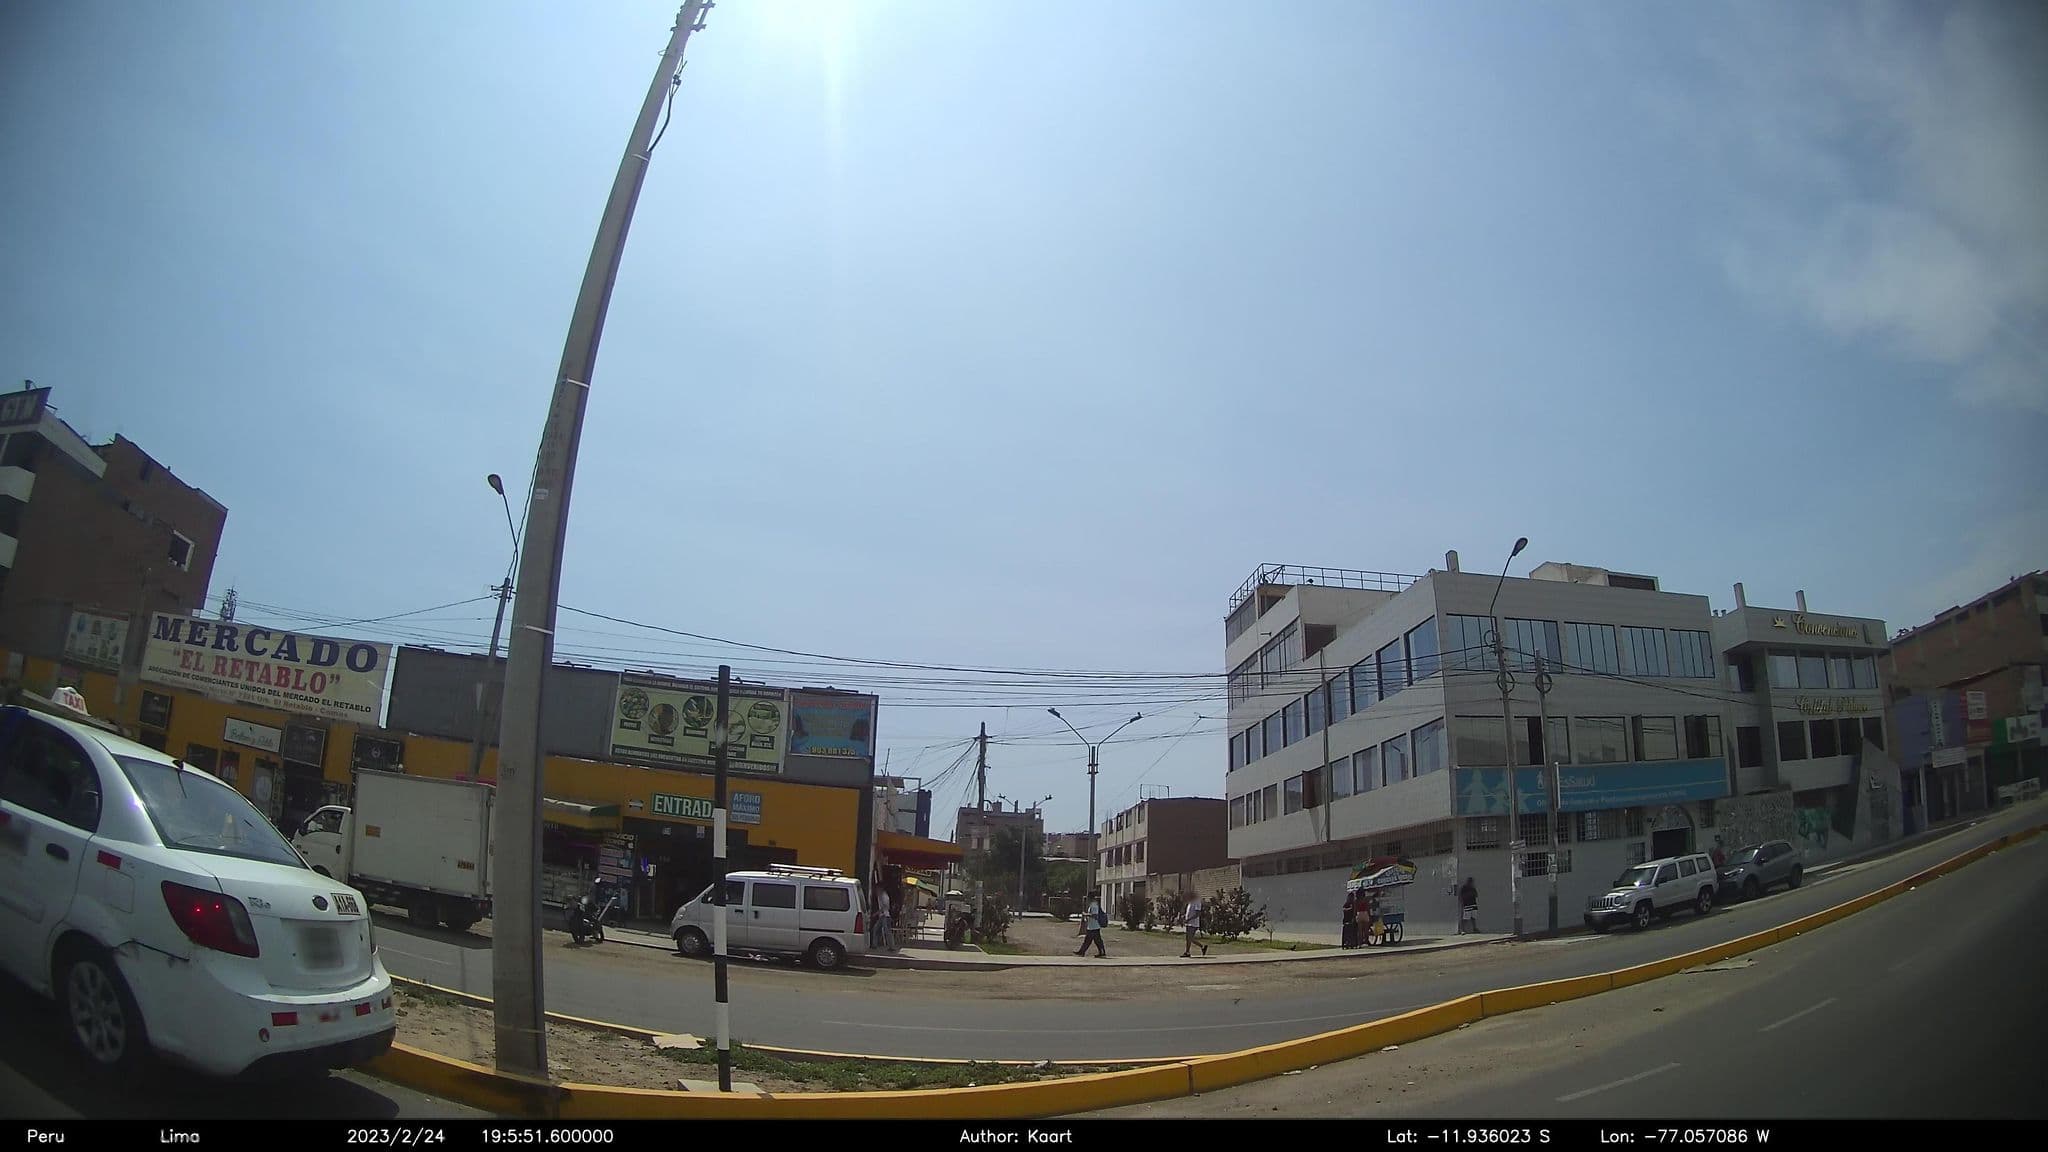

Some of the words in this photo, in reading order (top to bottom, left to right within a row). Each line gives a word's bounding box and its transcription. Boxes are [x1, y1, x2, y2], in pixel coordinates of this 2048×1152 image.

[152, 615, 378, 673] MERCADO
[64, 691, 85, 712] TAXI
[182, 672, 190, 680] DE
[192, 674, 239, 689] COMERCIANTES
[240, 684, 266, 695] UNIDOS
[268, 690, 281, 698] DEL
[283, 692, 320, 704] MERCADO
[322, 698, 332, 706] EL
[333, 700, 371, 713] RETABLO
[654, 794, 716, 818] ENTRAD
[733, 793, 761, 803] AFORO
